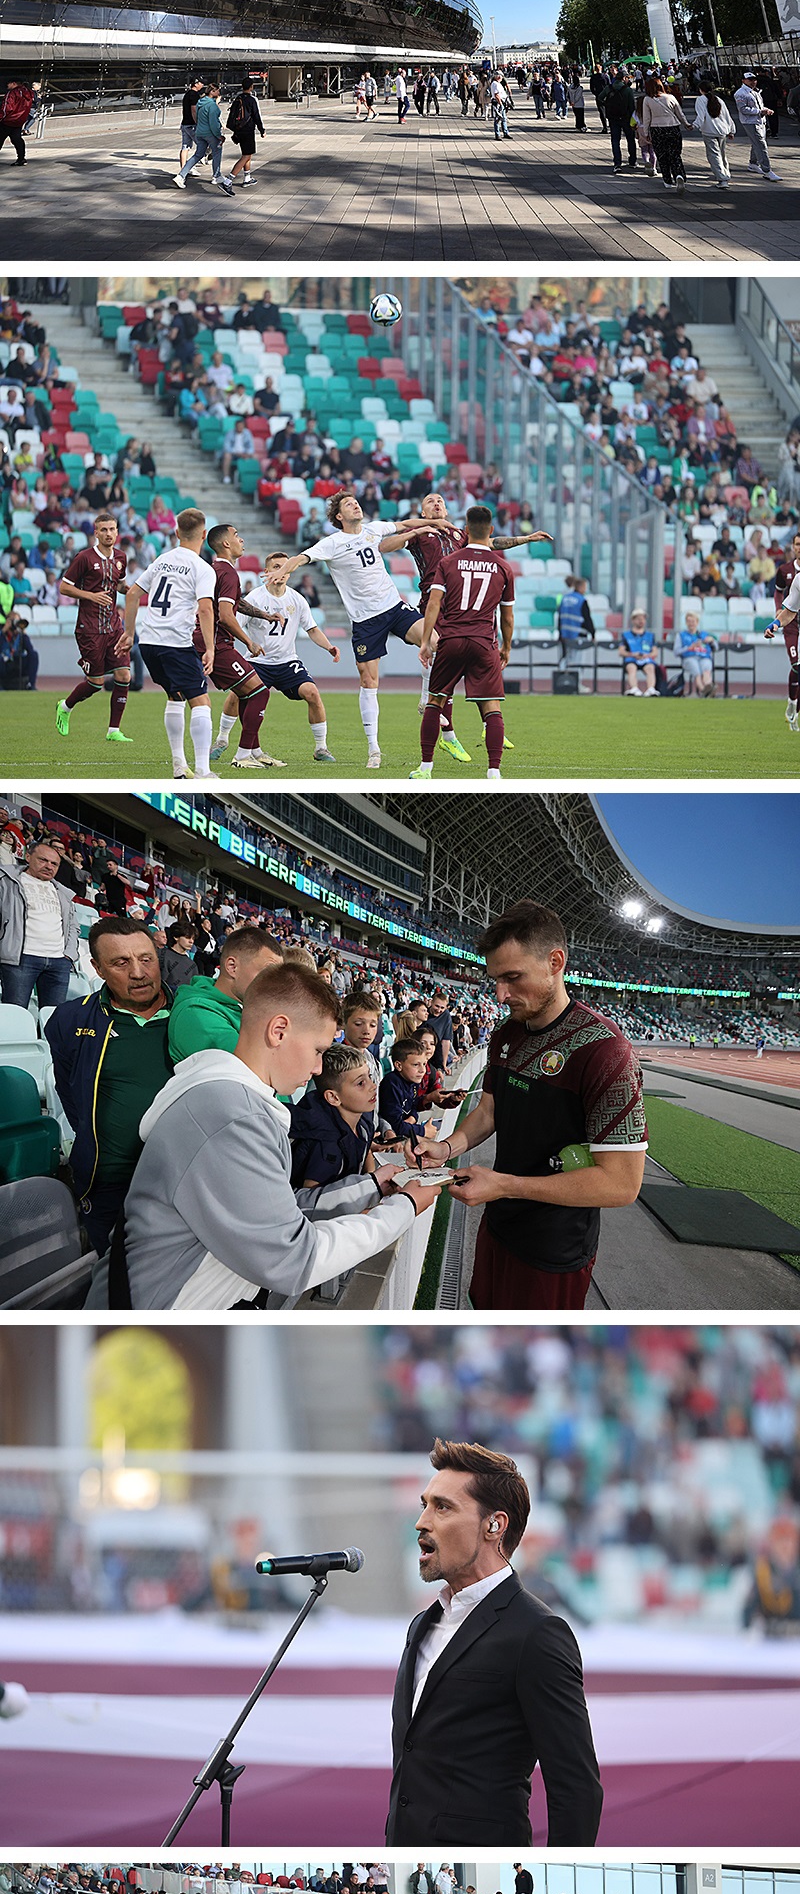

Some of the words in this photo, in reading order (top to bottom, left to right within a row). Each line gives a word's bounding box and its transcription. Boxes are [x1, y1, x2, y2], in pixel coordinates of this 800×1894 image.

[356, 547, 376, 568] 19
[457, 559, 498, 574] HRAMYKA
[151, 576, 173, 617] 4
[460, 570, 492, 611] 17
[790, 646, 797, 658] 6
[231, 661, 246, 676] 9
[230, 831, 298, 886] BETERA
[303, 876, 350, 913] BETERA
[353, 904, 391, 931] BETERA
[704, 1873, 714, 1883] A2
